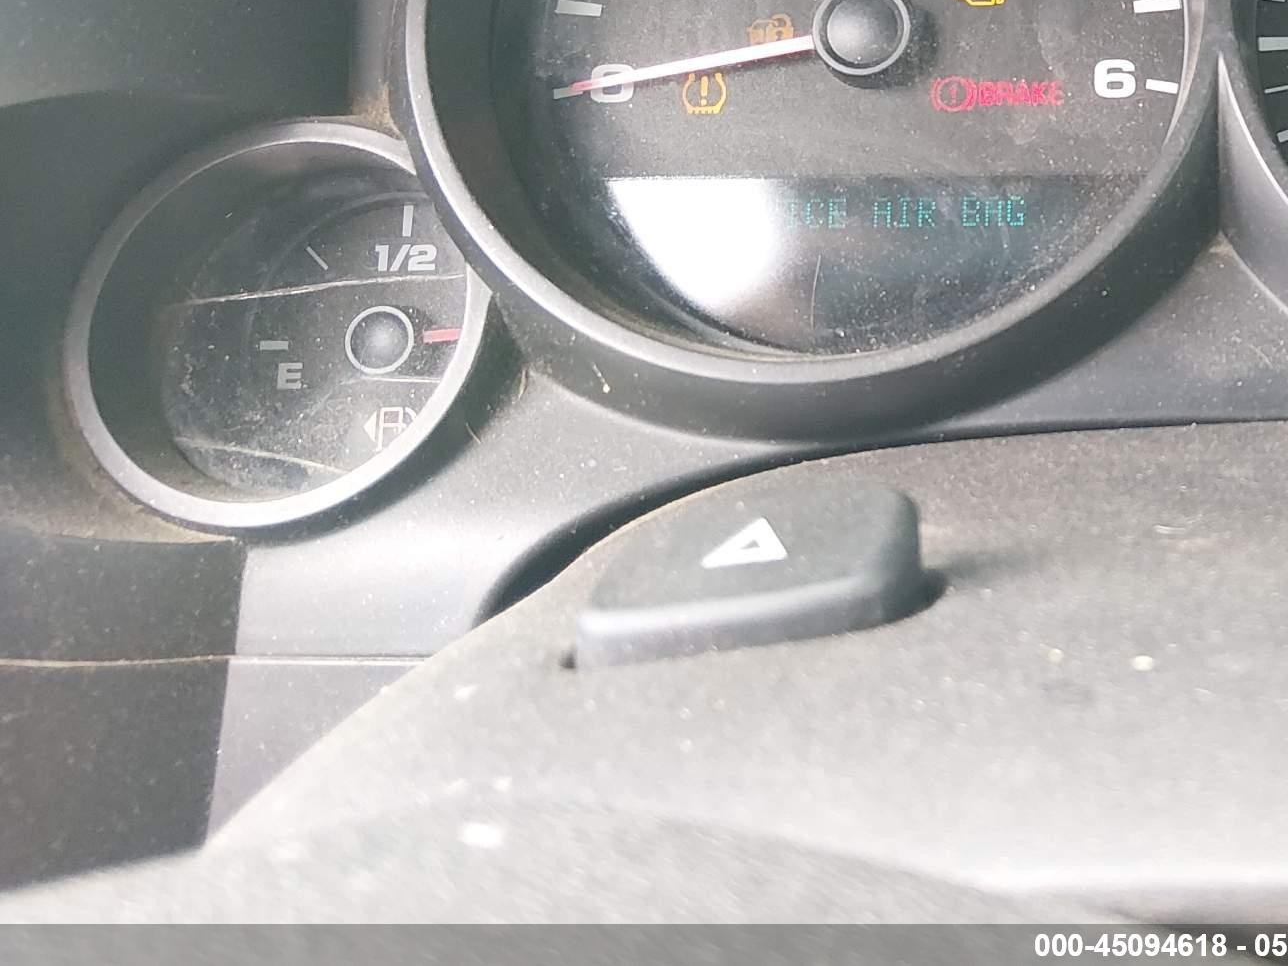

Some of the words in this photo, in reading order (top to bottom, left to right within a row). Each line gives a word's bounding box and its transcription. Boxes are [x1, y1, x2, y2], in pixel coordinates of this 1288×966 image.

[590, 63, 635, 103] 0
[977, 80, 1065, 106] BRAKE
[1094, 59, 1137, 98] 6
[873, 196, 937, 228] AIR
[963, 195, 1025, 228] BAG
[375, 244, 438, 272] 1/2
[277, 362, 303, 390] E
